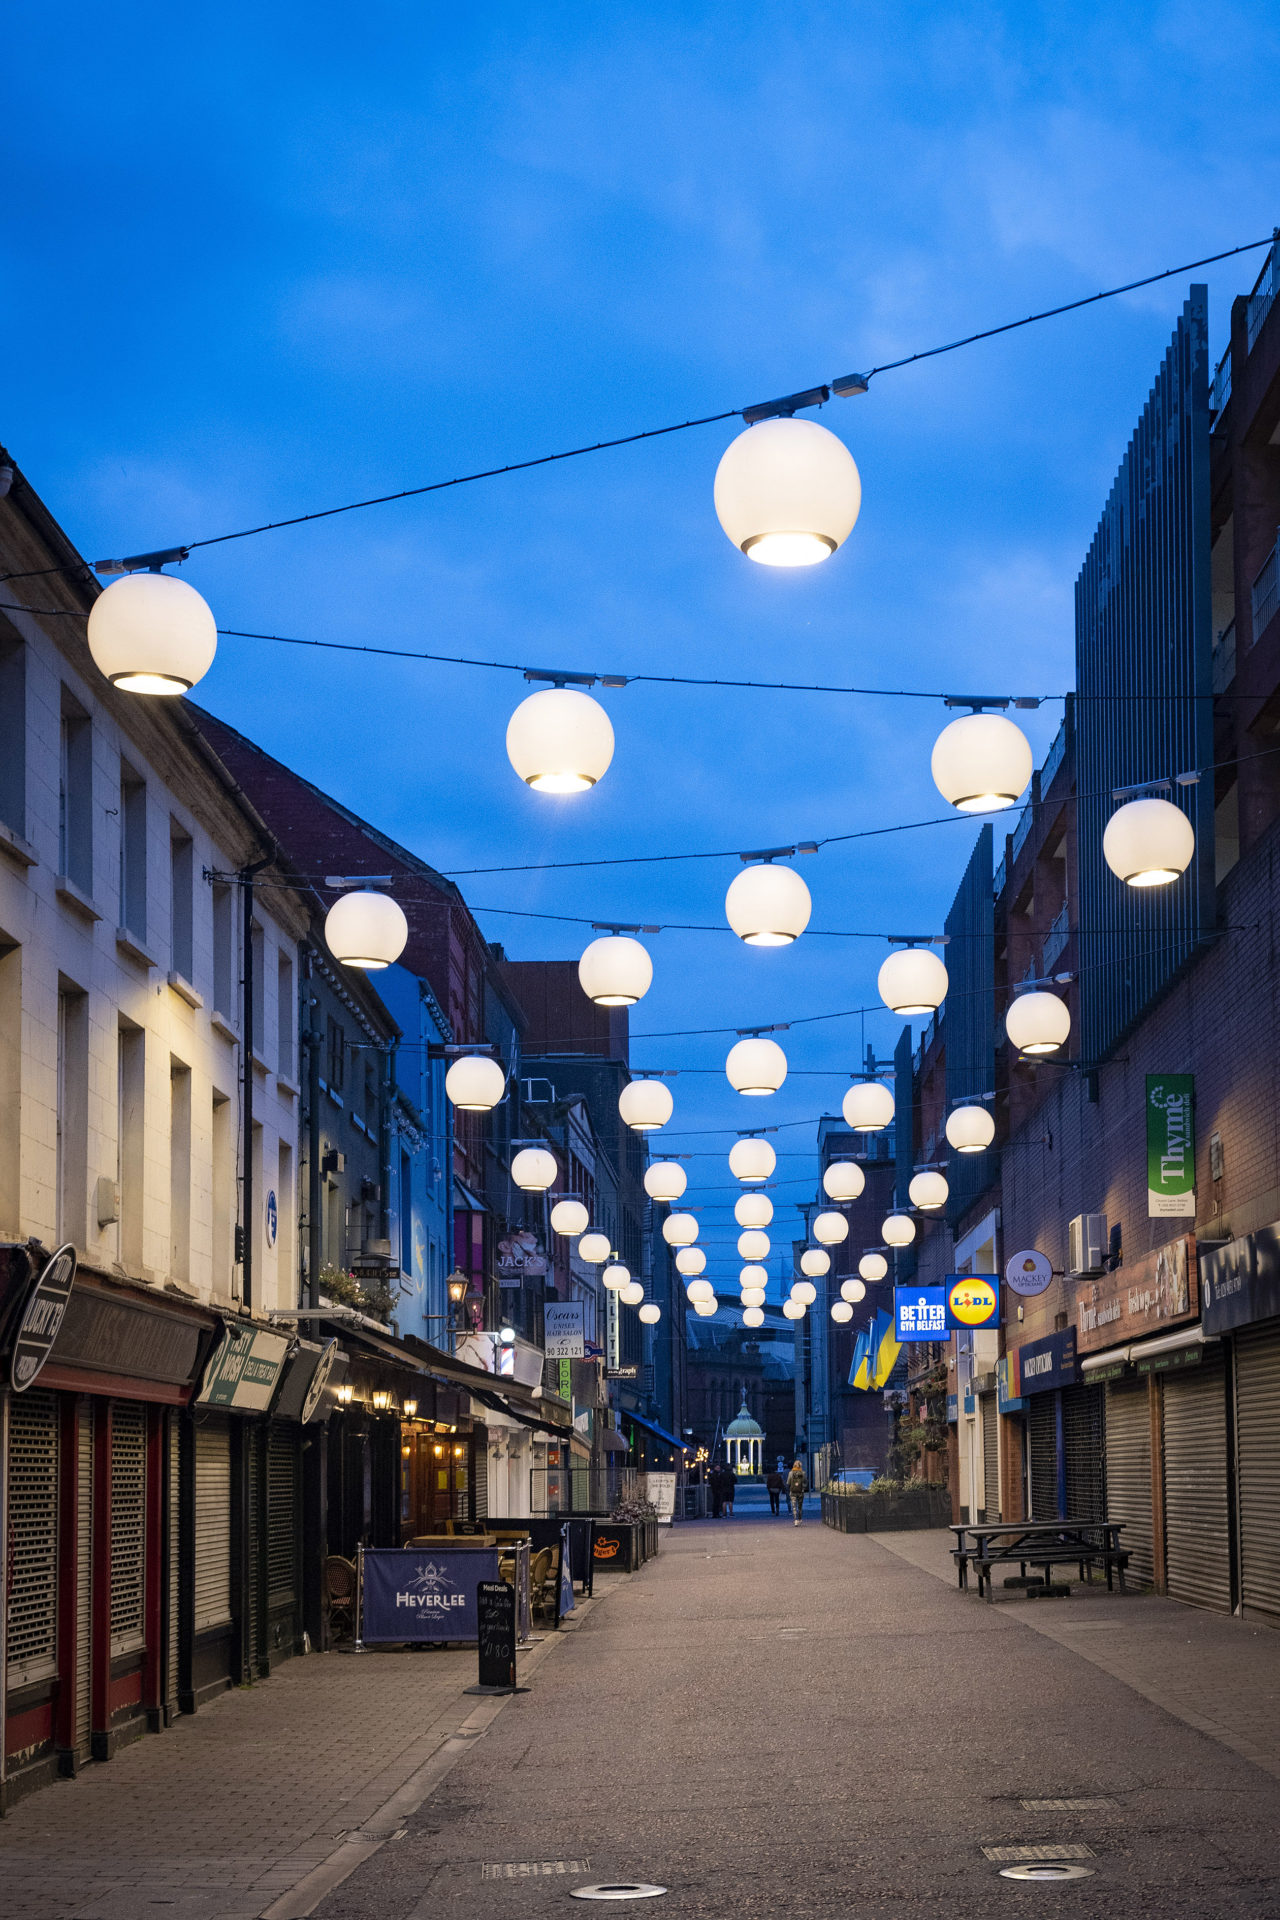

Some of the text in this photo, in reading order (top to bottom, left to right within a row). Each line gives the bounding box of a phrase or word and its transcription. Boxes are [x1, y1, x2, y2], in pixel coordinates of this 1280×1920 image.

[1161, 1093, 1191, 1184] Thyme
[498, 1256, 544, 1267] JACK'S
[1013, 1274, 1047, 1283] MACKEY
[22, 1297, 56, 1334] LUCKY
[546, 1306, 579, 1321] Oscars
[900, 1304, 945, 1320] BETTER
[900, 1319, 945, 1331] GYM BELFAST
[547, 1347, 555, 1356] 90
[557, 1347, 569, 1355] 322
[571, 1346, 582, 1355] 121
[219, 1353, 245, 1382] NOSH
[396, 1592, 465, 1611] HEVERLEE
